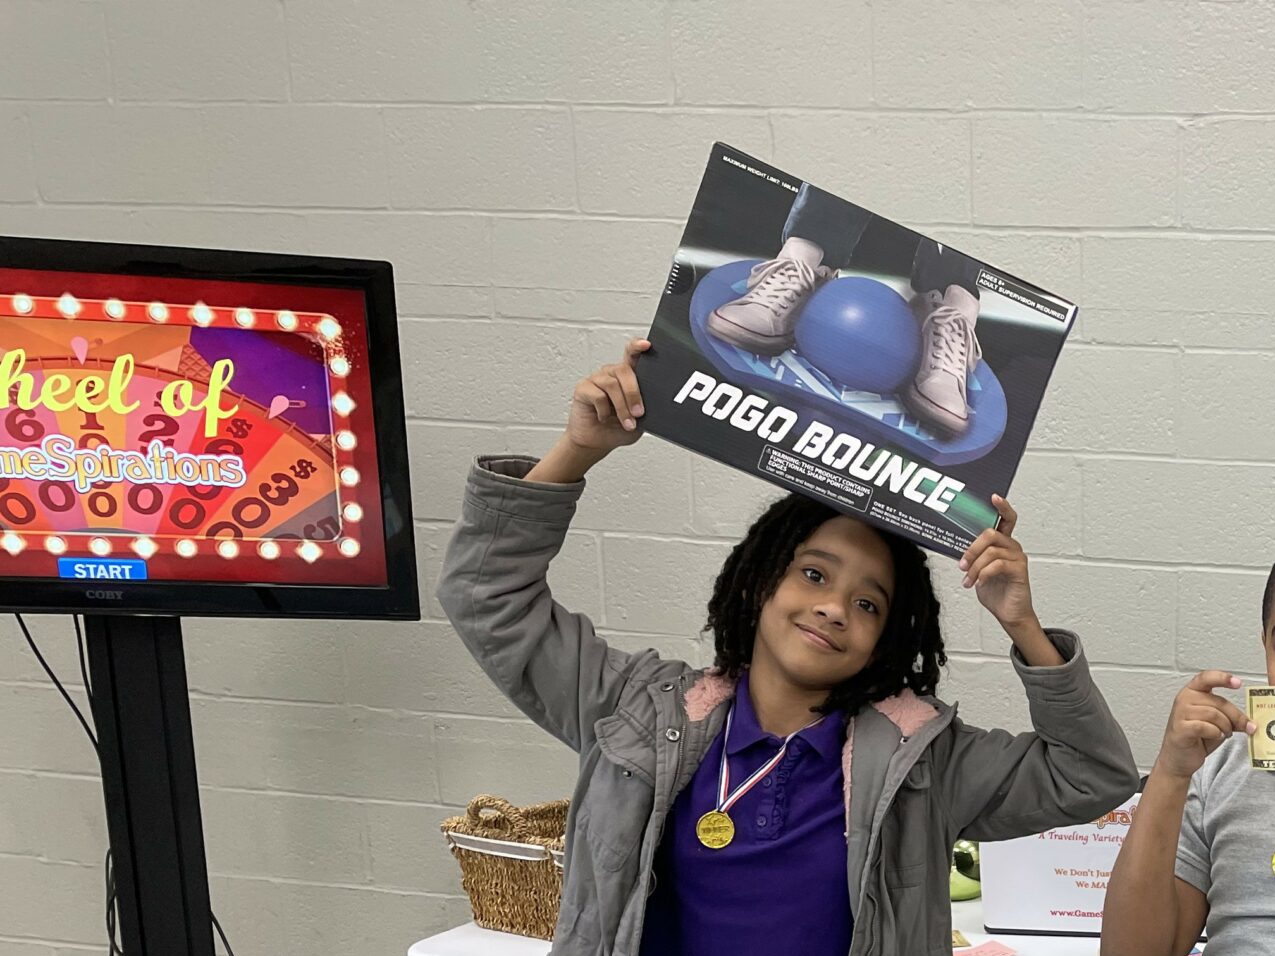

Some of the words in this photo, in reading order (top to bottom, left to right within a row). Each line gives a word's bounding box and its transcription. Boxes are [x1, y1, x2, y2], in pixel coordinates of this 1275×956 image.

[747, 166, 767, 179] WEIGHT
[981, 272, 997, 284] AGES
[979, 279, 998, 290] ADULT
[998, 287, 1036, 307] SUPERVISION
[1035, 303, 1065, 320] REQUIRED
[161, 358, 239, 438] of
[673, 370, 798, 443] POGO
[792, 420, 966, 513] BOUNCE
[768, 461, 787, 472] EDGES
[772, 449, 801, 466] WARNING:
[801, 461, 815, 472] THIS
[814, 467, 842, 482] PRODUCT
[842, 478, 871, 495] CONTAINS
[770, 454, 806, 474] FUNCTIONAL
[807, 470, 827, 482] SHARP
[826, 478, 865, 497] POINT/SHARP
[74, 564, 133, 579] START
[86, 589, 123, 600] COBY
[1038, 832, 1045, 840] A
[1048, 830, 1089, 845] Traveling
[1092, 833, 1126, 847] Variety
[1054, 868, 1068, 876] We
[1070, 868, 1094, 877] Don't
[1096, 869, 1113, 878] Jus
[1076, 880, 1089, 889] We
[1091, 881, 1109, 889] MA
